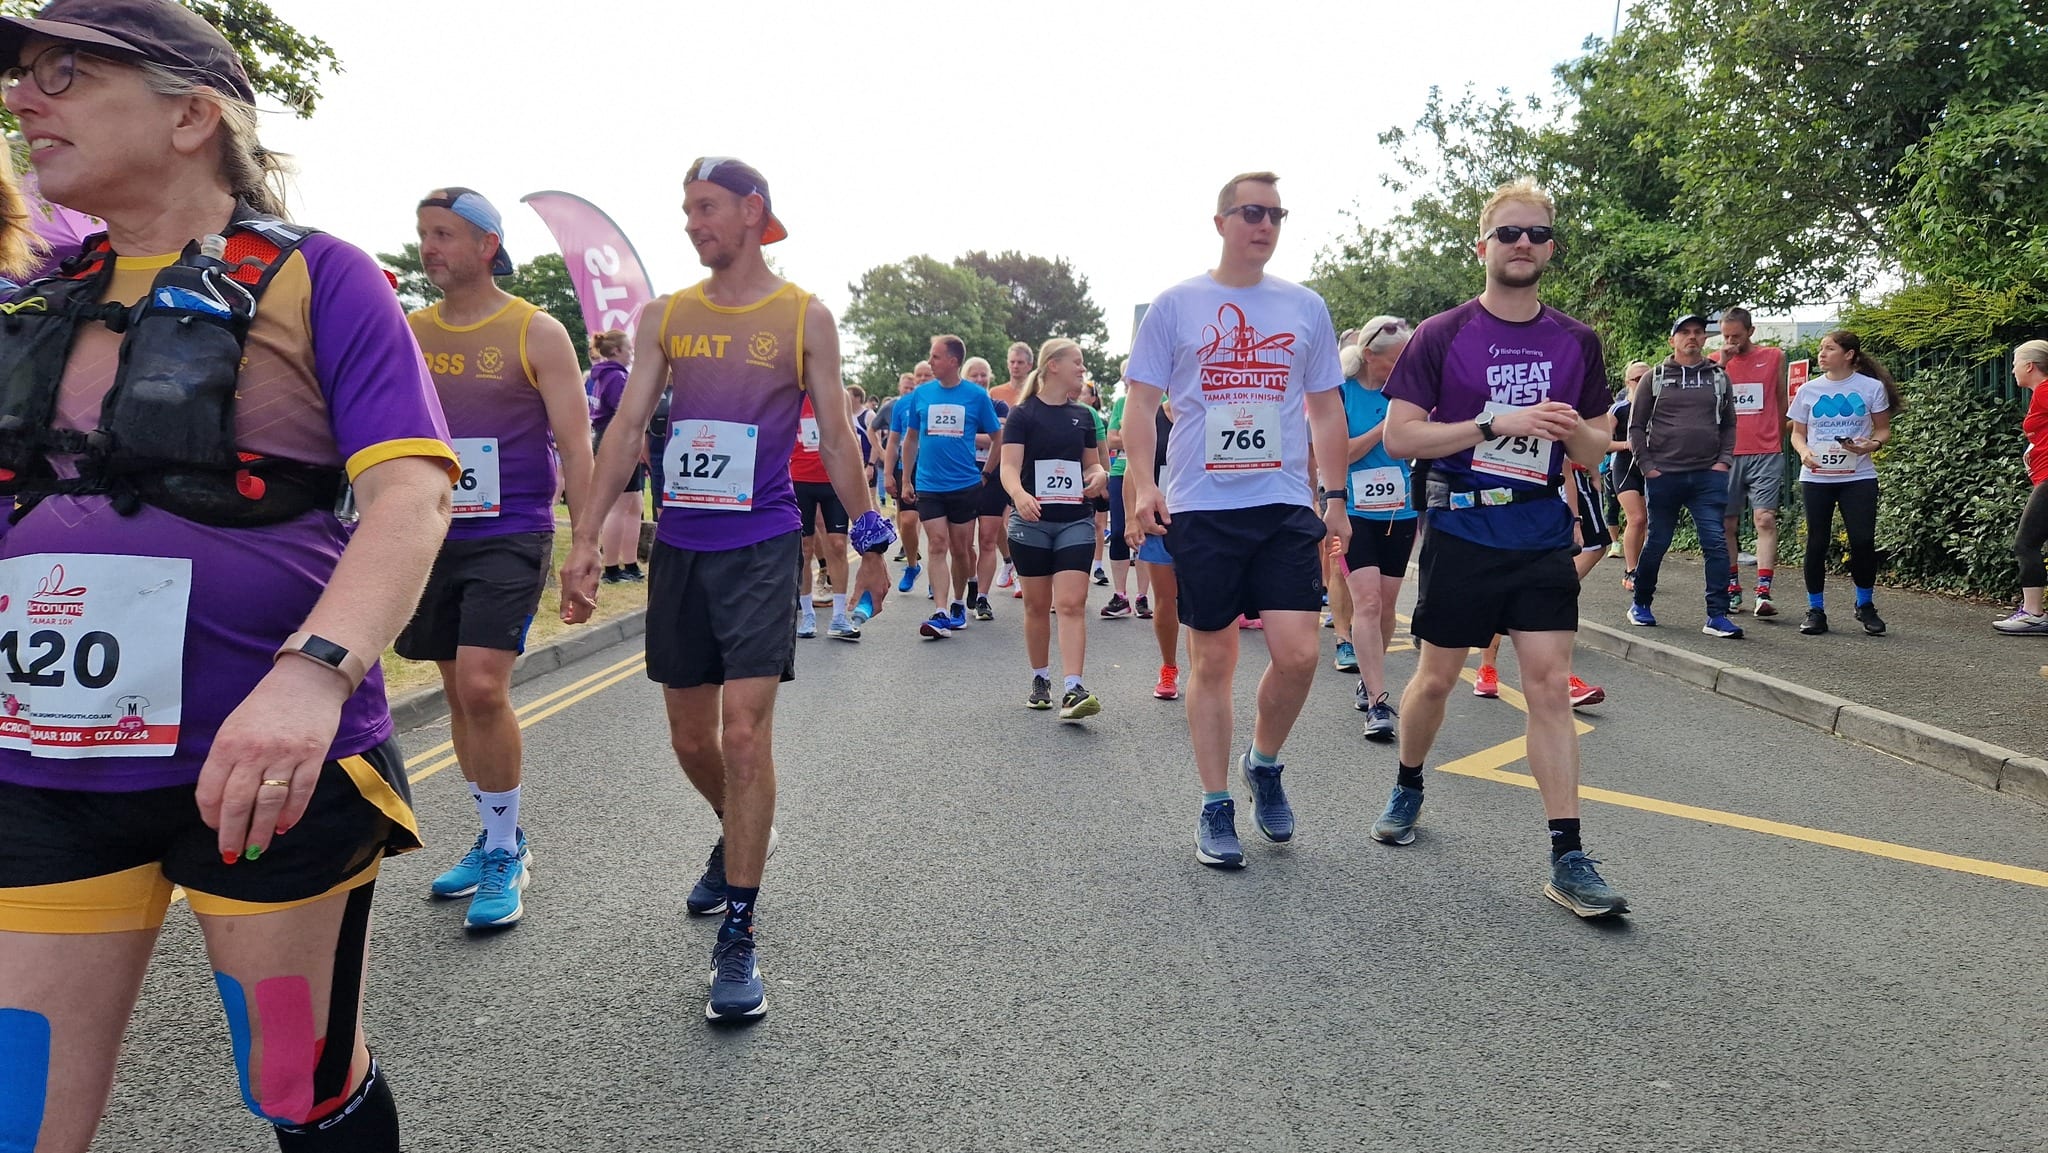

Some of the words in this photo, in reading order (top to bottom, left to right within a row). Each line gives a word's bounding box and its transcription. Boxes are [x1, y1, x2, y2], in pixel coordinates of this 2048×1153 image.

[671, 334, 732, 358] MAT
[1522, 348, 1543, 357] Fleming
[1201, 370, 1289, 389] Acronyms
[1487, 361, 1552, 386] GREAT
[1204, 393, 1231, 401] TAMAR
[1491, 382, 1550, 404] WEST
[935, 415, 957, 425] 225
[1221, 429, 1266, 450] 766
[1494, 435, 1540, 458] 754
[679, 453, 731, 479] 127
[1822, 455, 1847, 465] 557
[1047, 476, 1072, 489] 279
[1365, 482, 1395, 497] 299
[0, 630, 120, 688] 120
[128, 703, 137, 716] M
[59, 732, 81, 741] 10K
